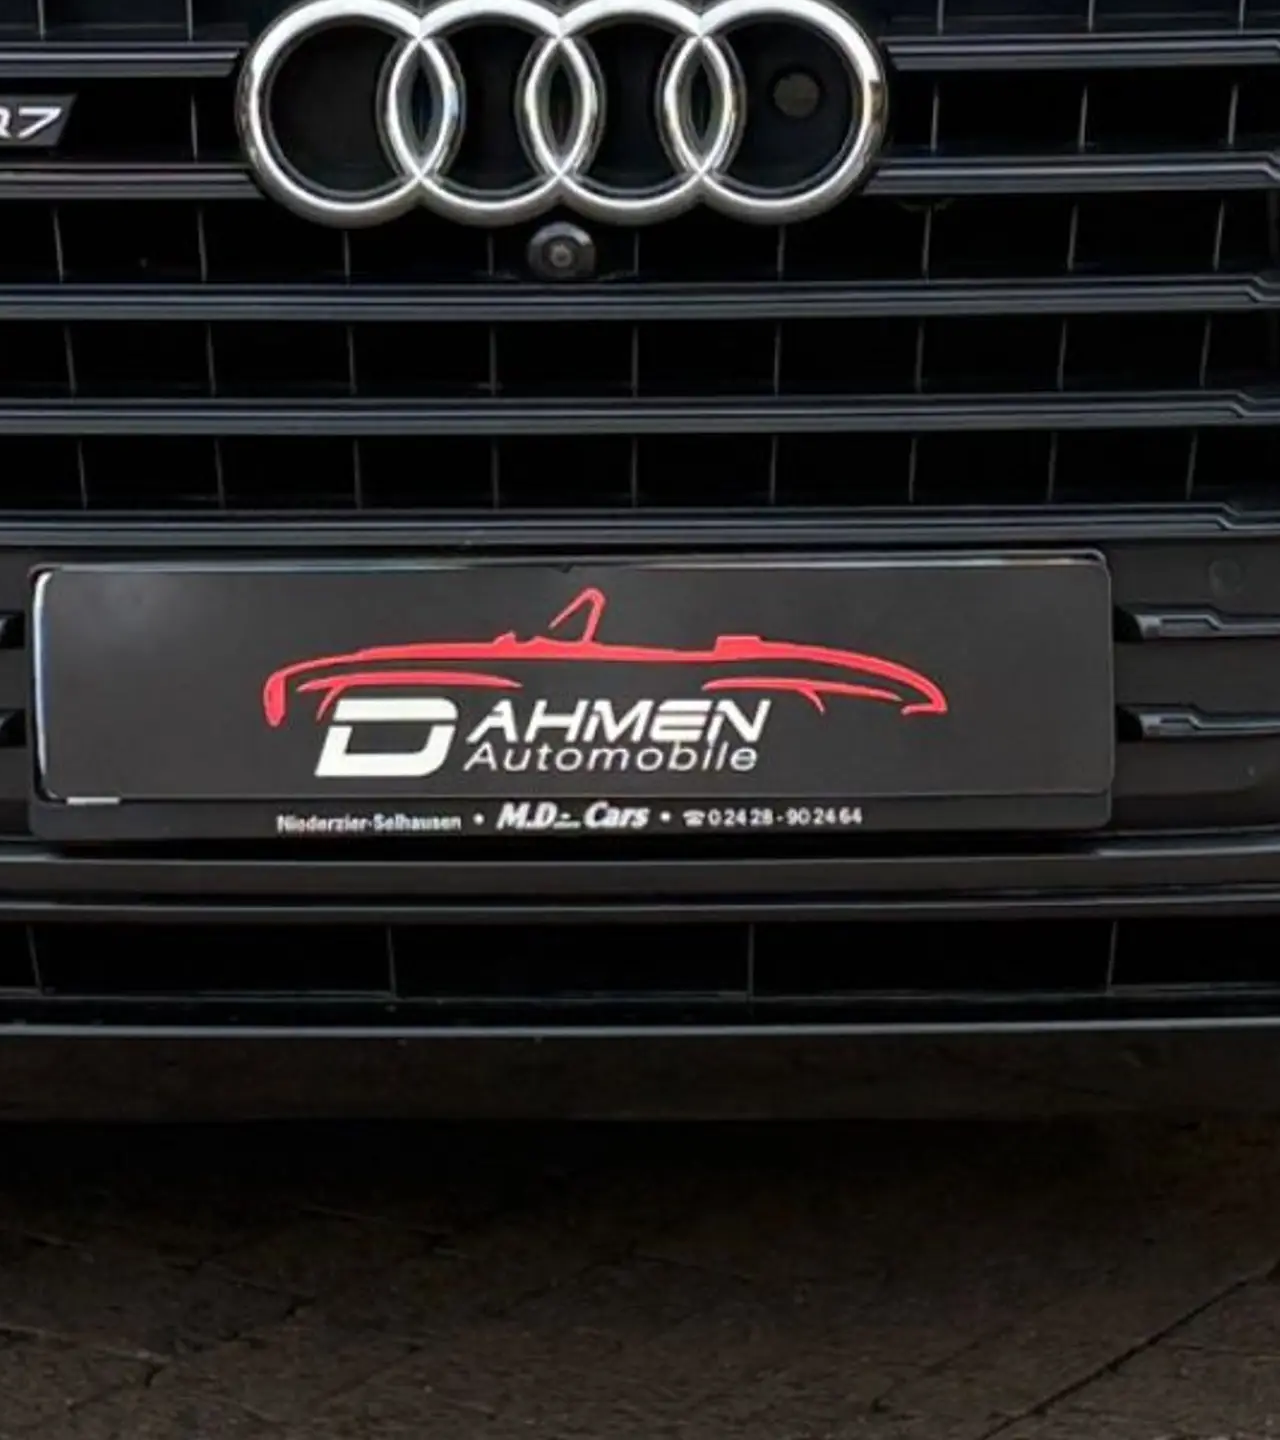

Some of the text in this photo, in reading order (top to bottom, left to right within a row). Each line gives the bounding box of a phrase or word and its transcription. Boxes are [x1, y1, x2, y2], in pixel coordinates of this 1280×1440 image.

[314, 697, 771, 778] DAHMEN
[463, 741, 758, 772] Automobile
[583, 801, 650, 829] Cars
